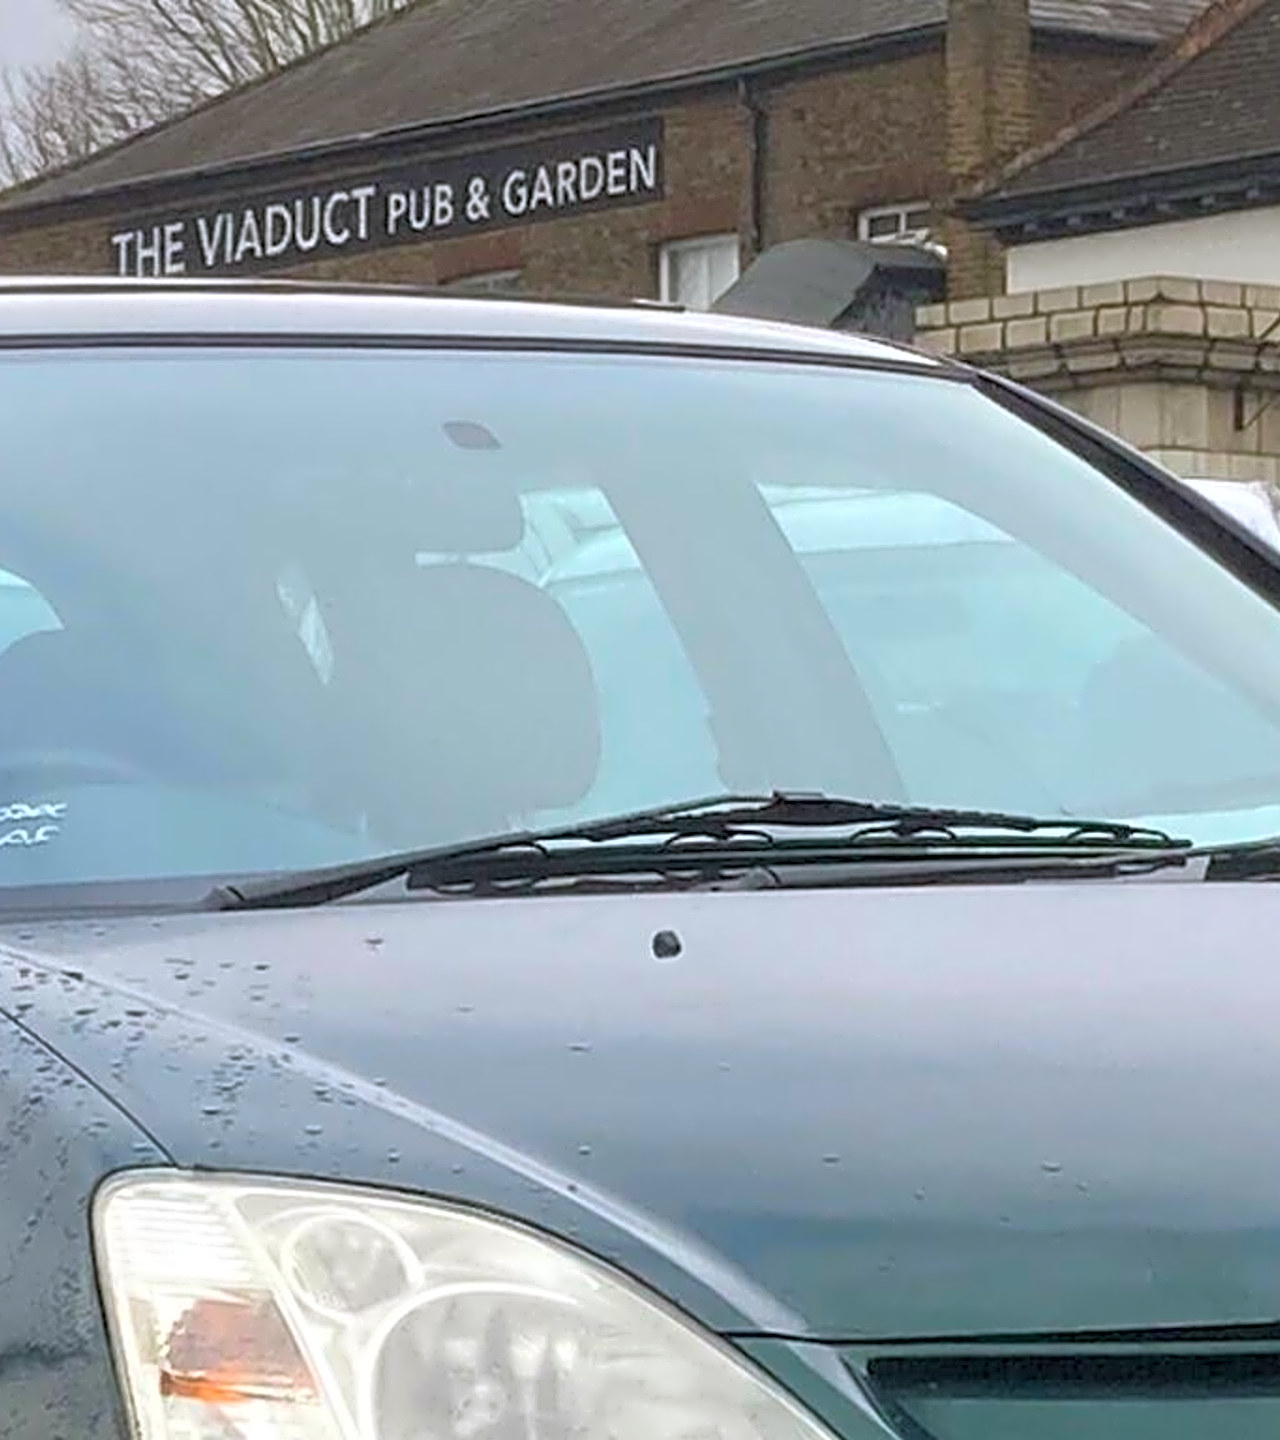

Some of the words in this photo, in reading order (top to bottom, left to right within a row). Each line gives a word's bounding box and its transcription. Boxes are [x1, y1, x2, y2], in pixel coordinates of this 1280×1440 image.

[112, 222, 186, 277] THE
[197, 185, 375, 267] VIADUCT
[387, 184, 454, 234] PUB
[466, 177, 490, 220] &
[503, 145, 656, 214] GARDEN
